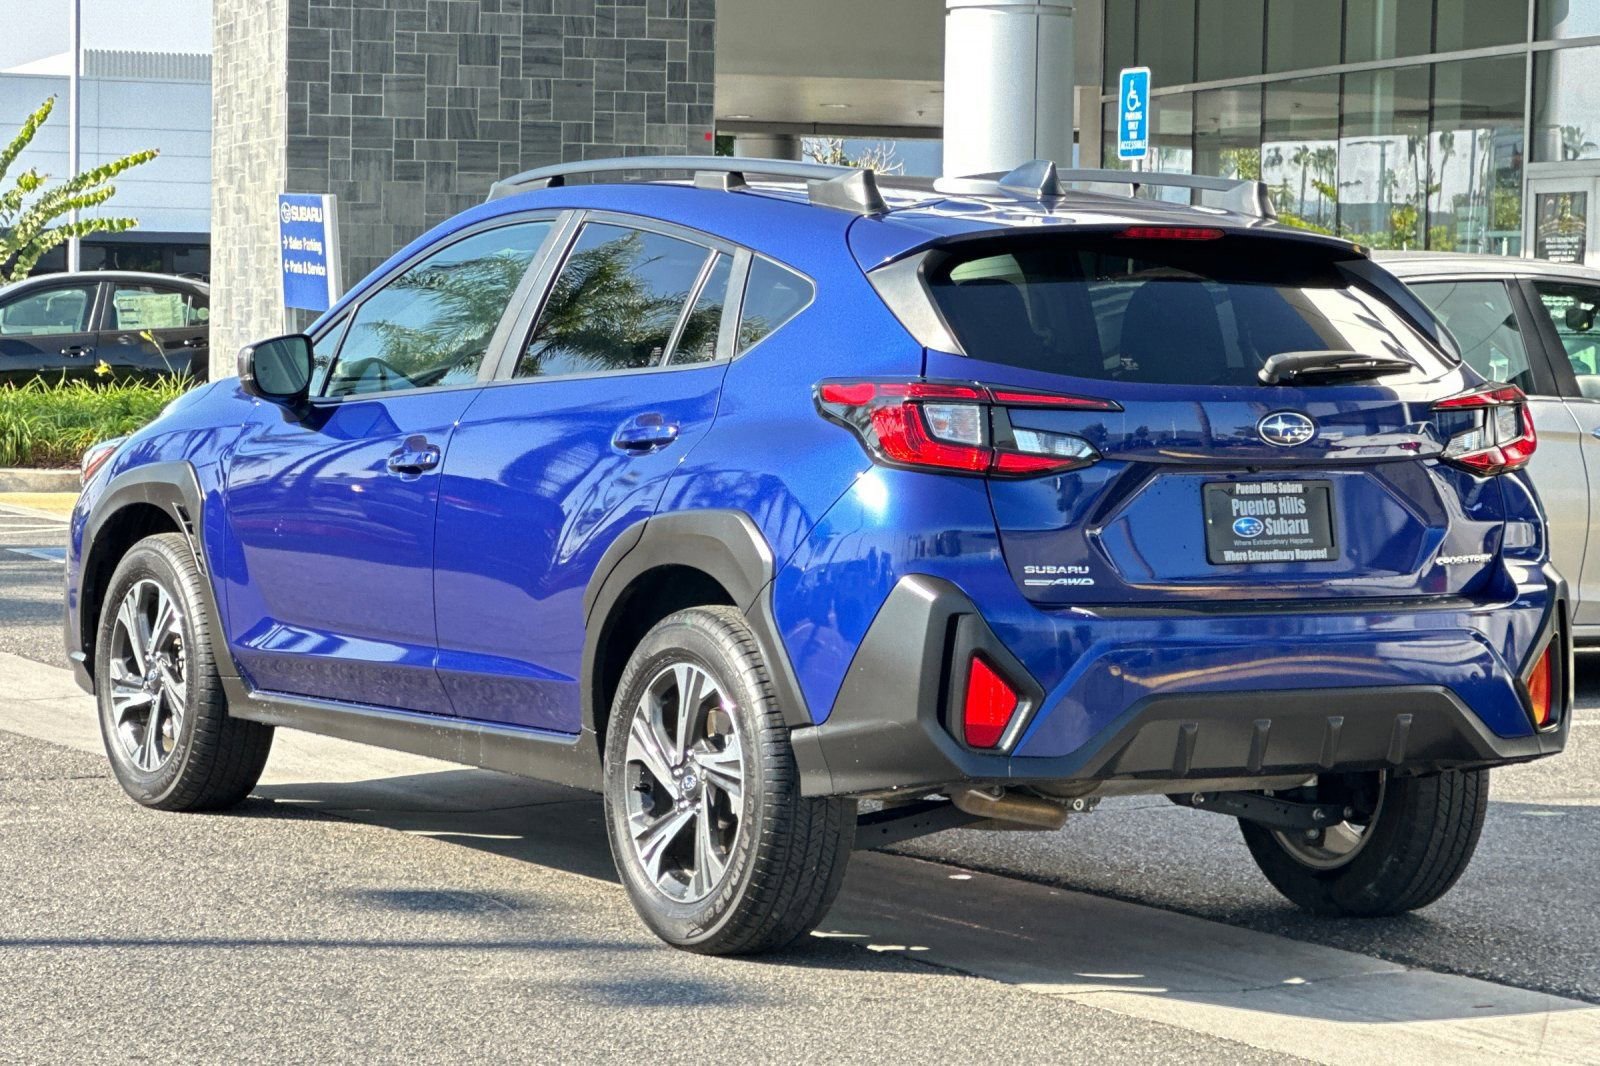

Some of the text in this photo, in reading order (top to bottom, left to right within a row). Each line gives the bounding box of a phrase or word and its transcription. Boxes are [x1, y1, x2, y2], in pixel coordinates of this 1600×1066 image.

[291, 205, 322, 222] SUBARU
[289, 235, 322, 255] Sales Parking
[290, 261, 302, 274] Parts
[308, 262, 326, 276] Service
[1236, 482, 1303, 494] Puente Hills Subaru
[1232, 496, 1307, 516] Puente Hills
[1265, 517, 1309, 535] Subaru
[1252, 538, 1288, 546] Extraordinary
[1290, 537, 1313, 545] Happens
[1224, 548, 1327, 561] Where Extraordinary Happens!
[1024, 565, 1090, 574] SUBARU
